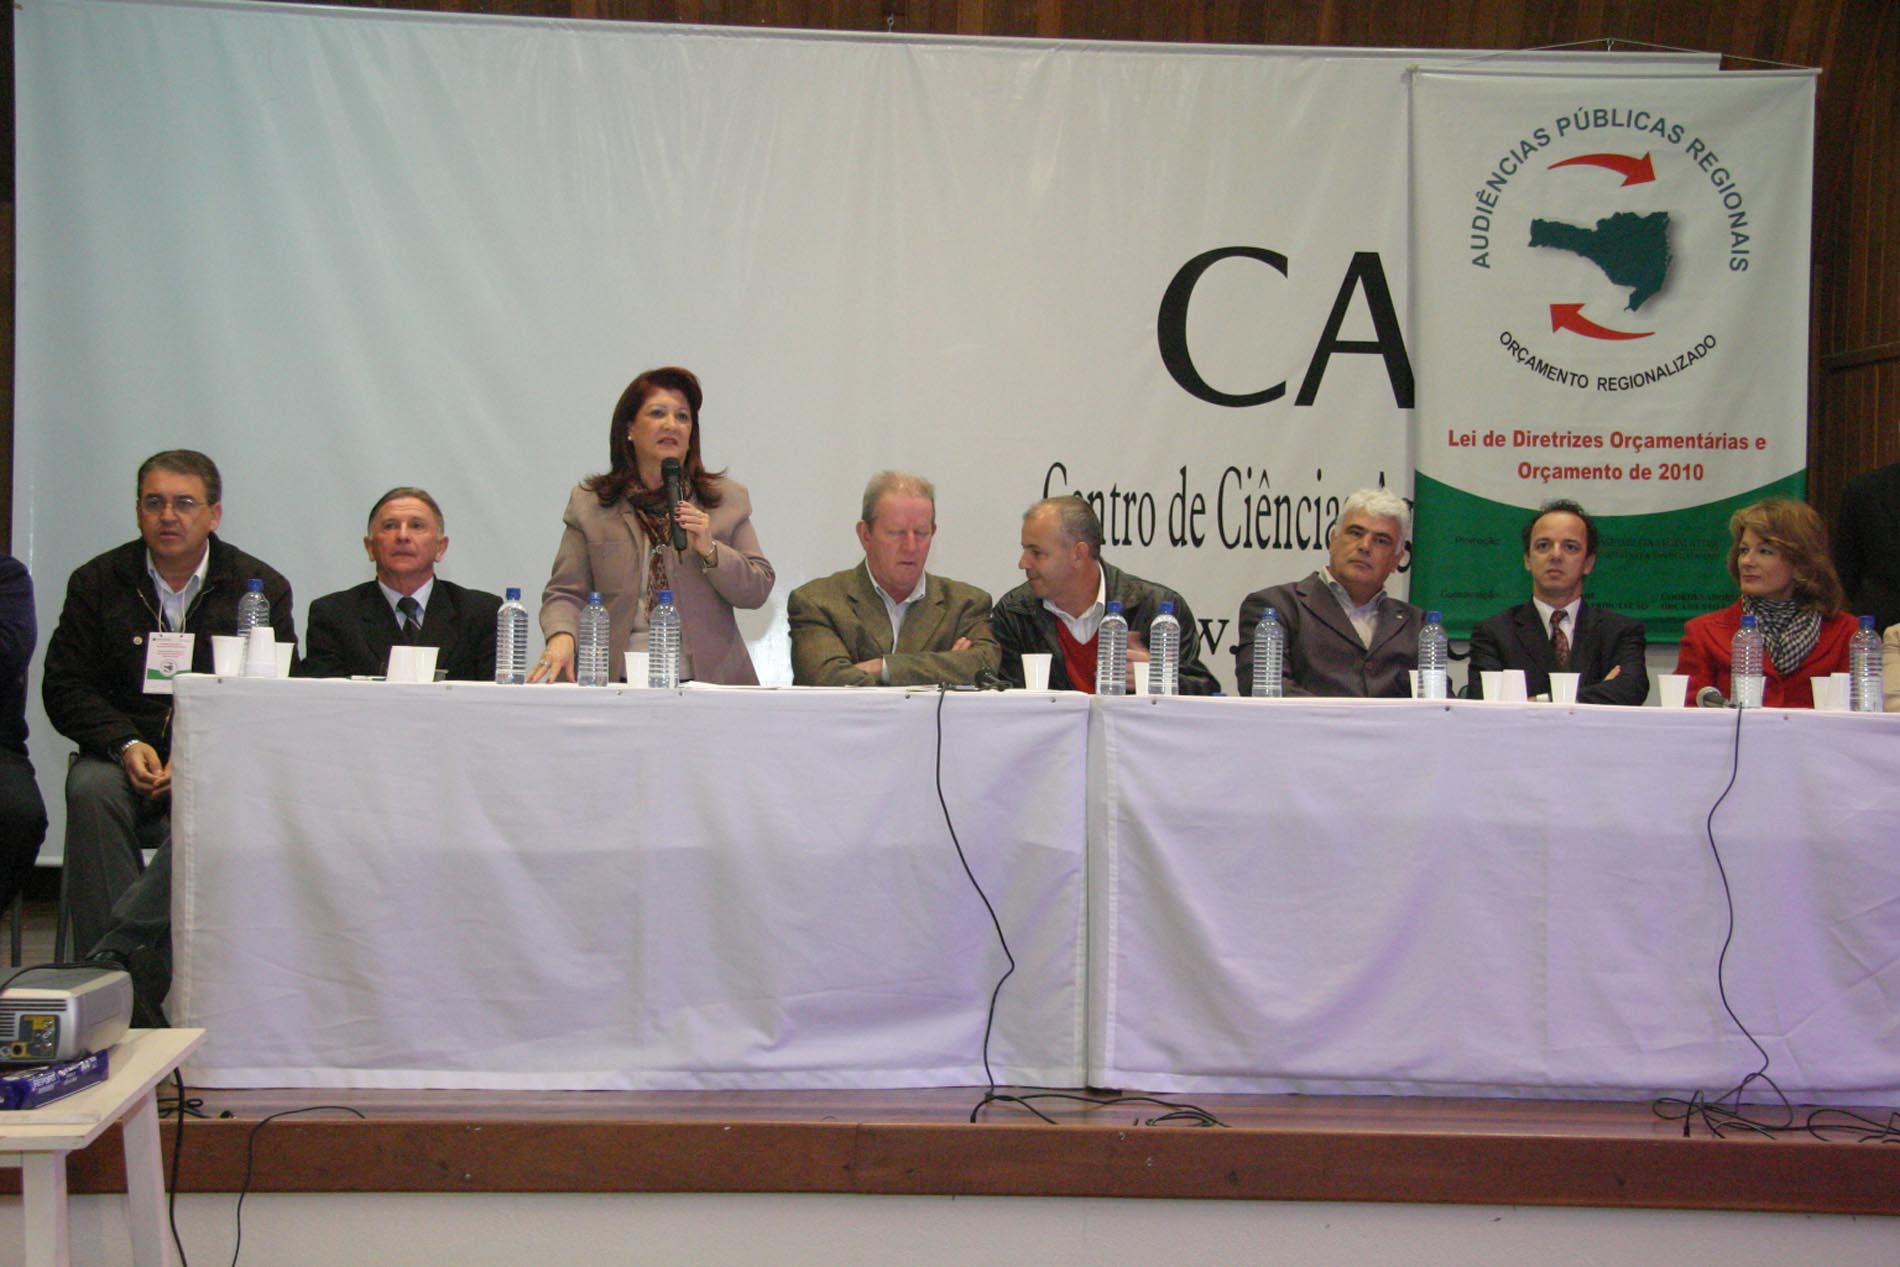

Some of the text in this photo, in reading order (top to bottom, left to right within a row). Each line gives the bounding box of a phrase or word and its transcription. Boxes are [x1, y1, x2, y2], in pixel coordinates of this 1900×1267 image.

[1471, 106, 1751, 273] AUDIÊNCIAS PÚBLICAS REGIONAIS
[1499, 330, 1718, 391] ORÇAMENTO REGIONALIZADO
[1448, 429, 1767, 453] Lei de Diretrizes Orçamentárias e
[1518, 461, 1704, 484] Orçamento de 2010
[1043, 462, 1156, 547] Cntro
[1168, 465, 1206, 549] de
[1216, 466, 1348, 551] Ciência
